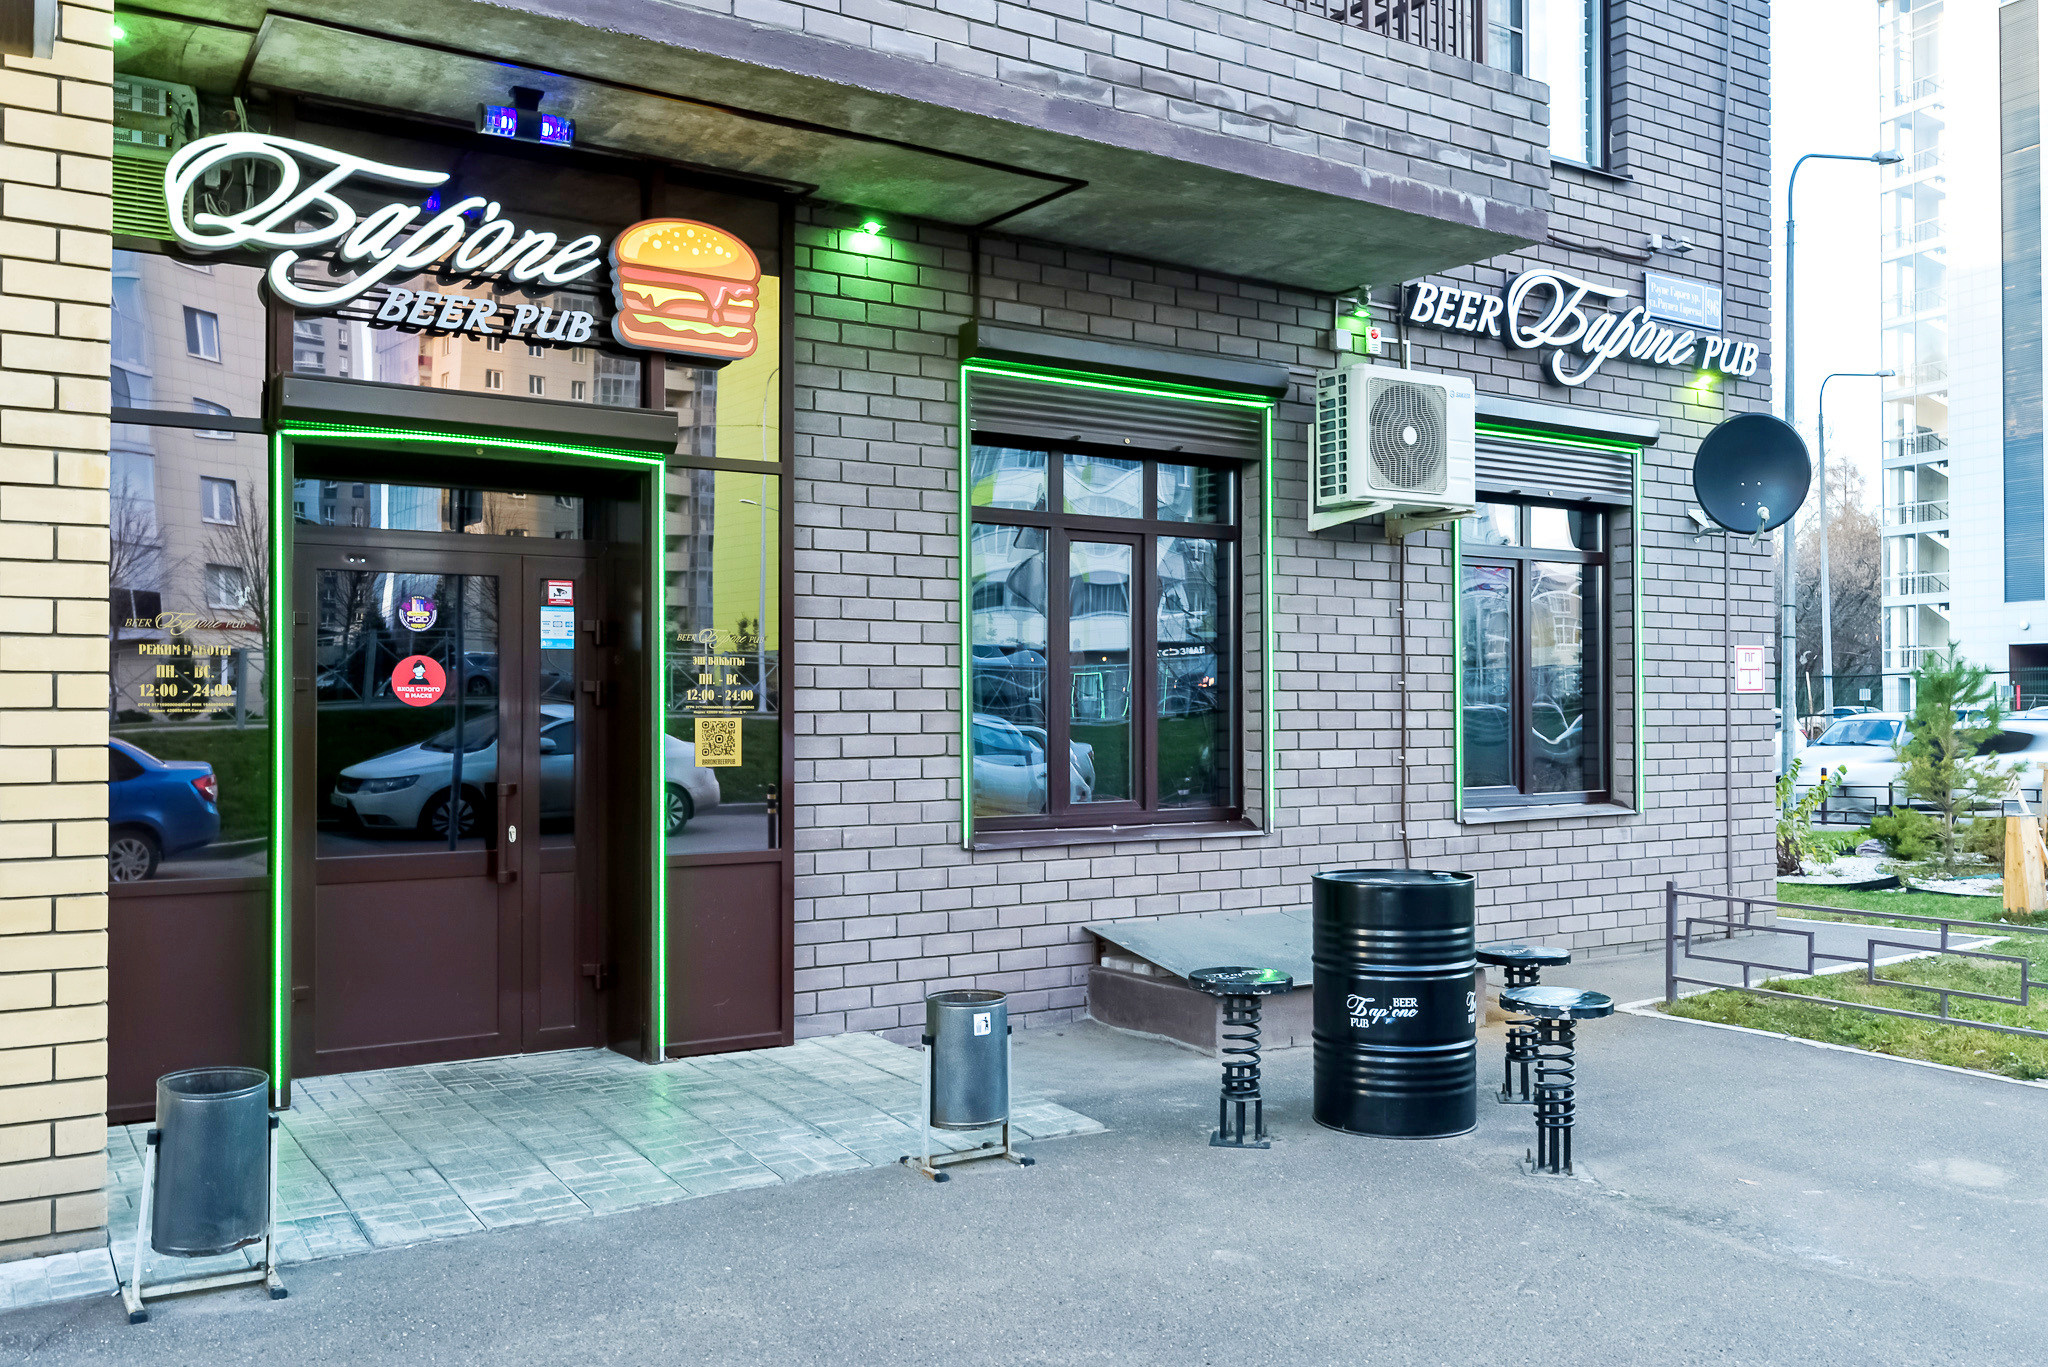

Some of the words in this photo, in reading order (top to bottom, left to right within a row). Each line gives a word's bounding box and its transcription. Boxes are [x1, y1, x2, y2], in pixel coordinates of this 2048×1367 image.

[1706, 299, 1720, 317] 96
[376, 287, 498, 334] BEER
[511, 304, 594, 343] PUB
[1410, 282, 1501, 337] BEER
[1702, 335, 1760, 377] PUB
[125, 618, 153, 628] BEER
[226, 620, 247, 629] PUB
[677, 633, 697, 642] BEER
[138, 643, 181, 656] РЕЖИМ
[183, 644, 232, 656] РАБОТЫ
[1745, 652, 1755, 663] ПГ
[156, 664, 179, 678] ПН.
[194, 664, 215, 678] ВС.
[698, 673, 716, 685] ПН.
[726, 673, 742, 686] ВС.
[139, 683, 178, 698] 12:00
[192, 683, 233, 698] 24:00
[686, 689, 715, 701] 12:00
[725, 689, 754, 701] 24:00
[1392, 997, 1418, 1007] BEER
[1350, 1017, 1370, 1028] PUB
